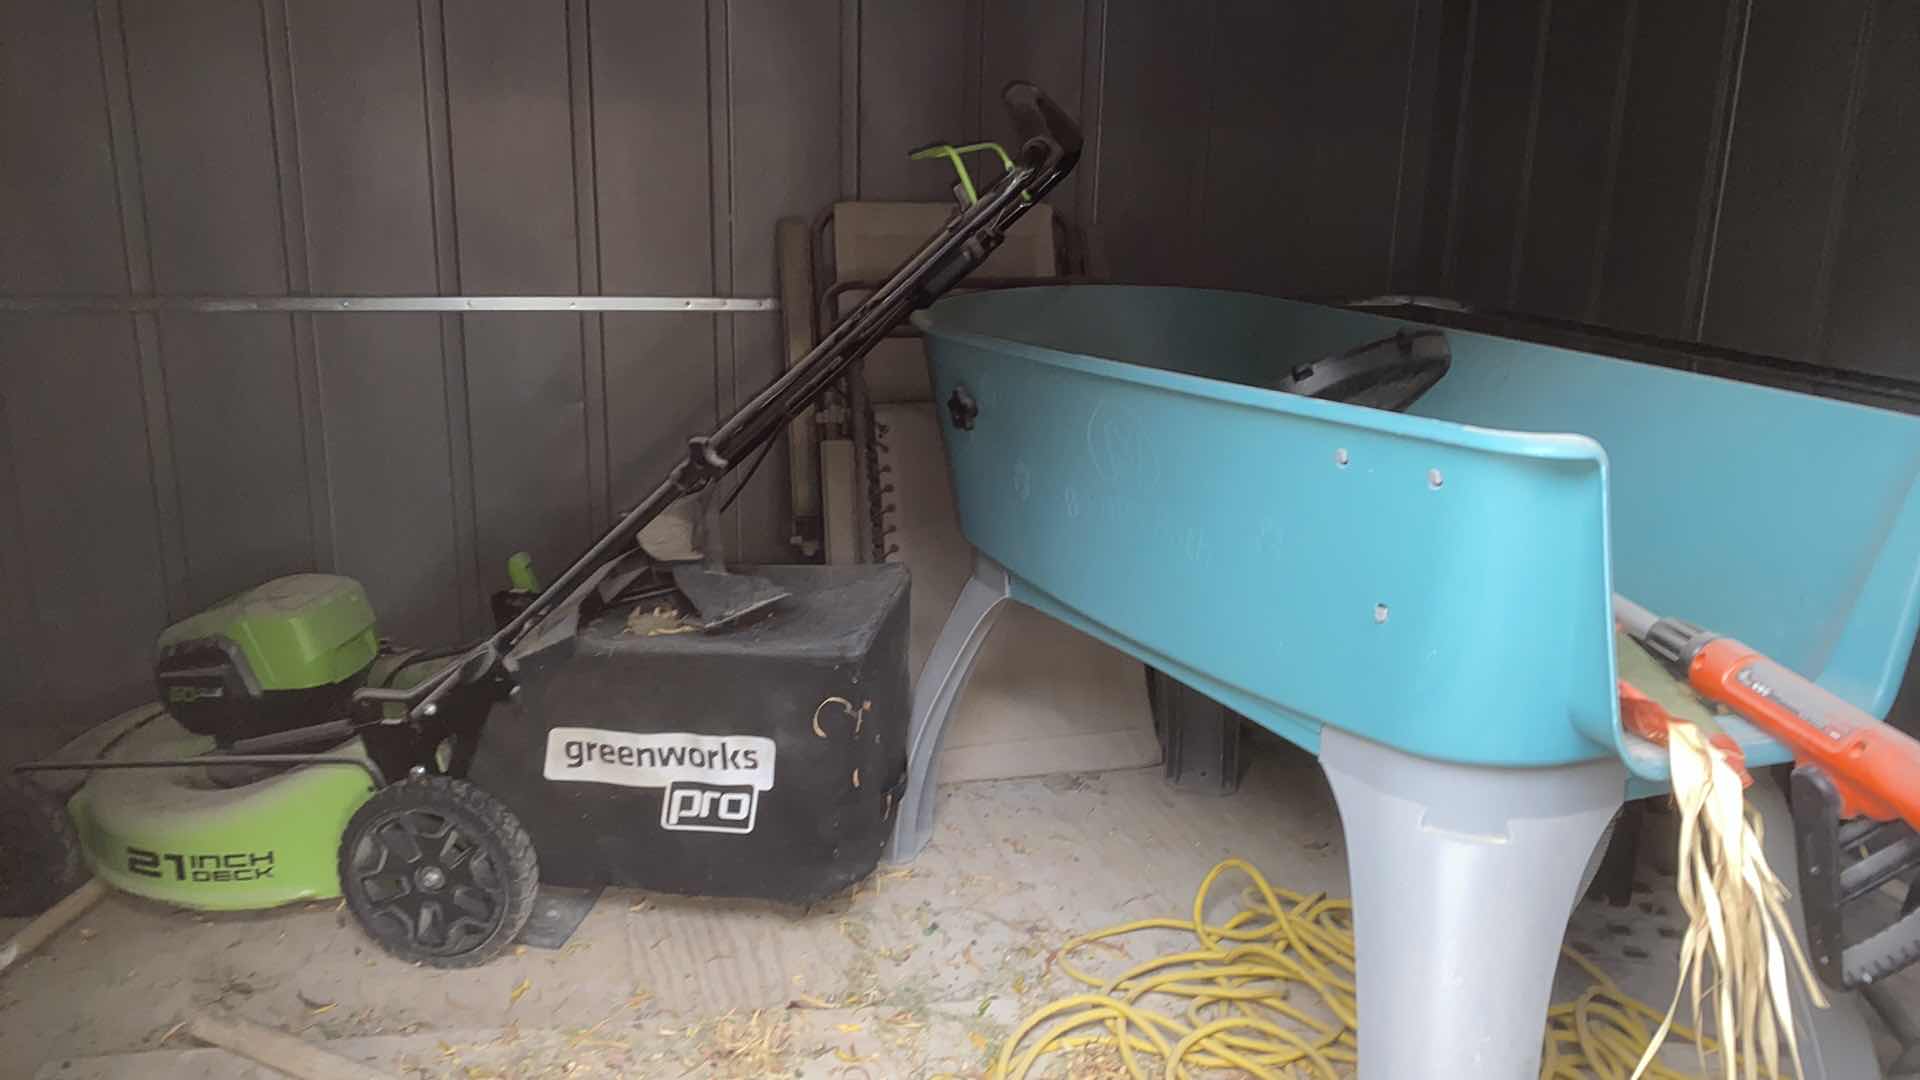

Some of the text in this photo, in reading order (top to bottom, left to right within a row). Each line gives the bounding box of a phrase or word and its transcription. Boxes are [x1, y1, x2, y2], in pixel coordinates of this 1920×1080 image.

[565, 740, 759, 770] greenworks
[669, 789, 751, 824] pro
[127, 847, 274, 880] 21 INCH
[192, 867, 273, 882] DECK
